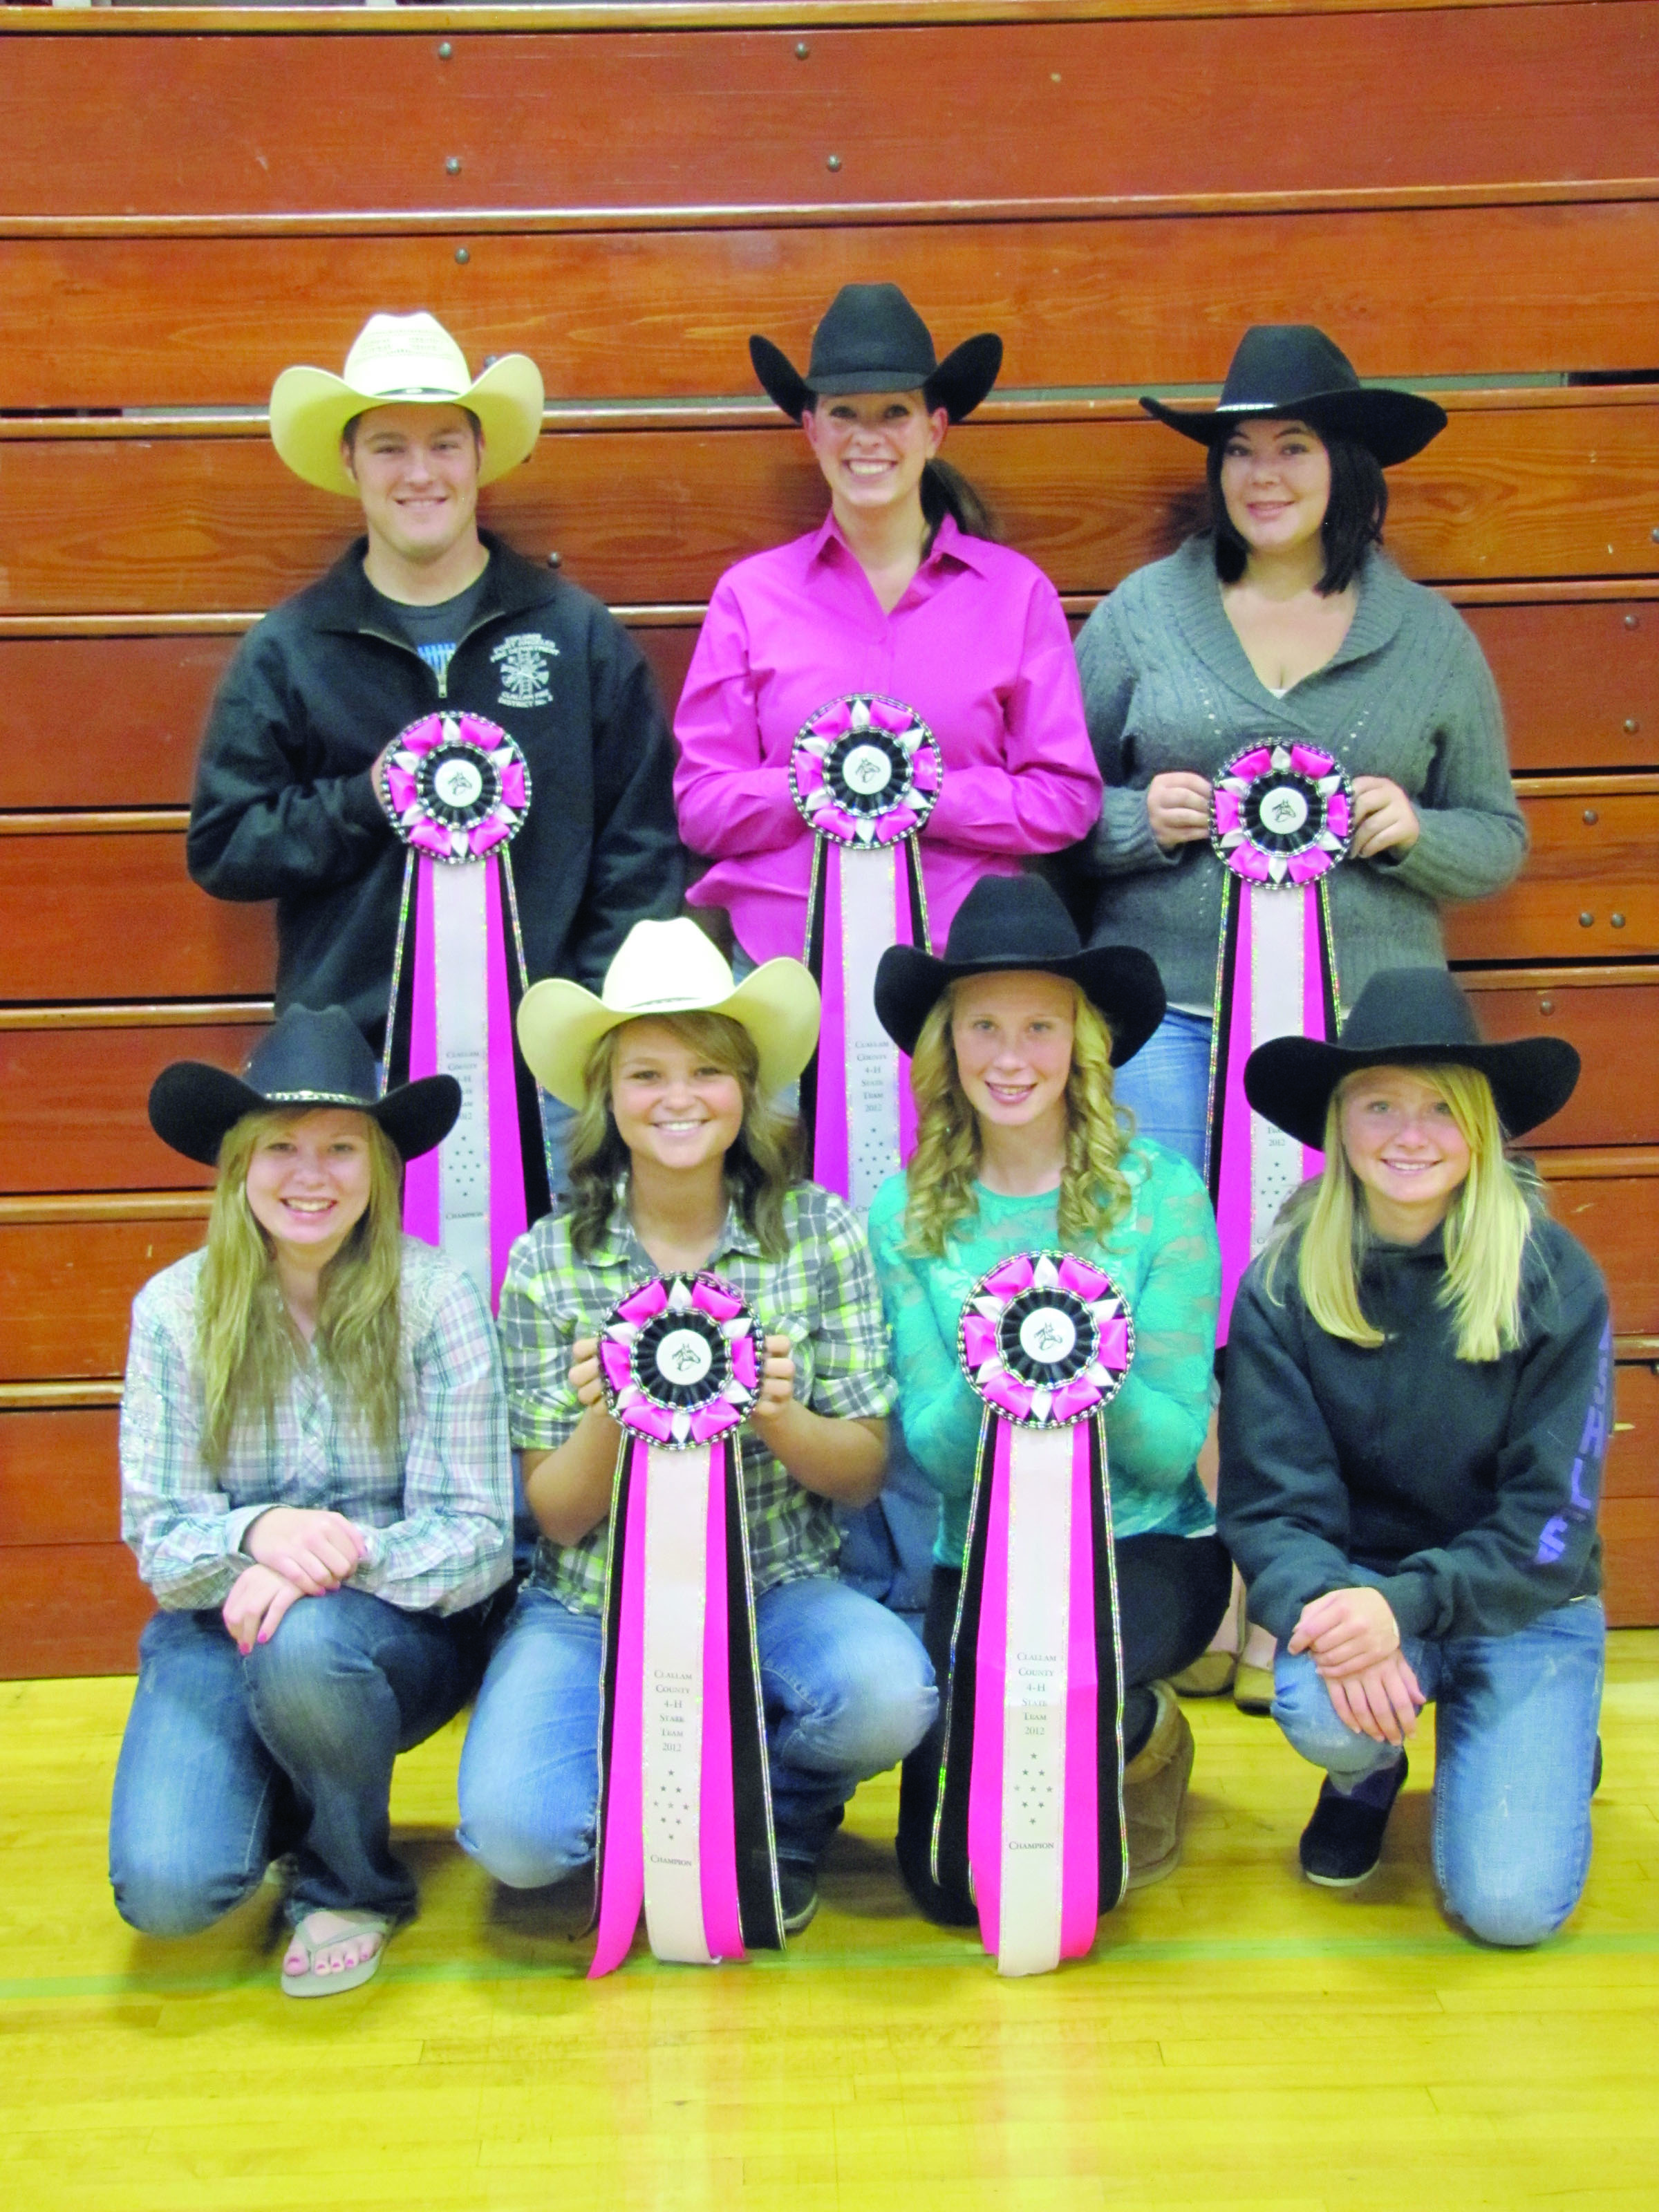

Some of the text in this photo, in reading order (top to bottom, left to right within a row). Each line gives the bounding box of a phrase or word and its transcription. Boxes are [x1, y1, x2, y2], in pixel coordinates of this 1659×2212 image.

[1017, 1651, 1056, 1662] CLALLAM
[654, 1669, 692, 1680] CLALLAM
[1018, 1667, 1054, 1677] COUNTY
[655, 1684, 691, 1694] COUNTY
[1027, 1683, 1046, 1692] 4-H
[664, 1700, 682, 1709] 4-H
[1024, 1712, 1047, 1721] TEAM
[1024, 1727, 1045, 1736] 2012
[662, 1742, 682, 1752] 2012
[1009, 1841, 1055, 1850] CHAMPION
[650, 1854, 692, 1867] CHAMPION
